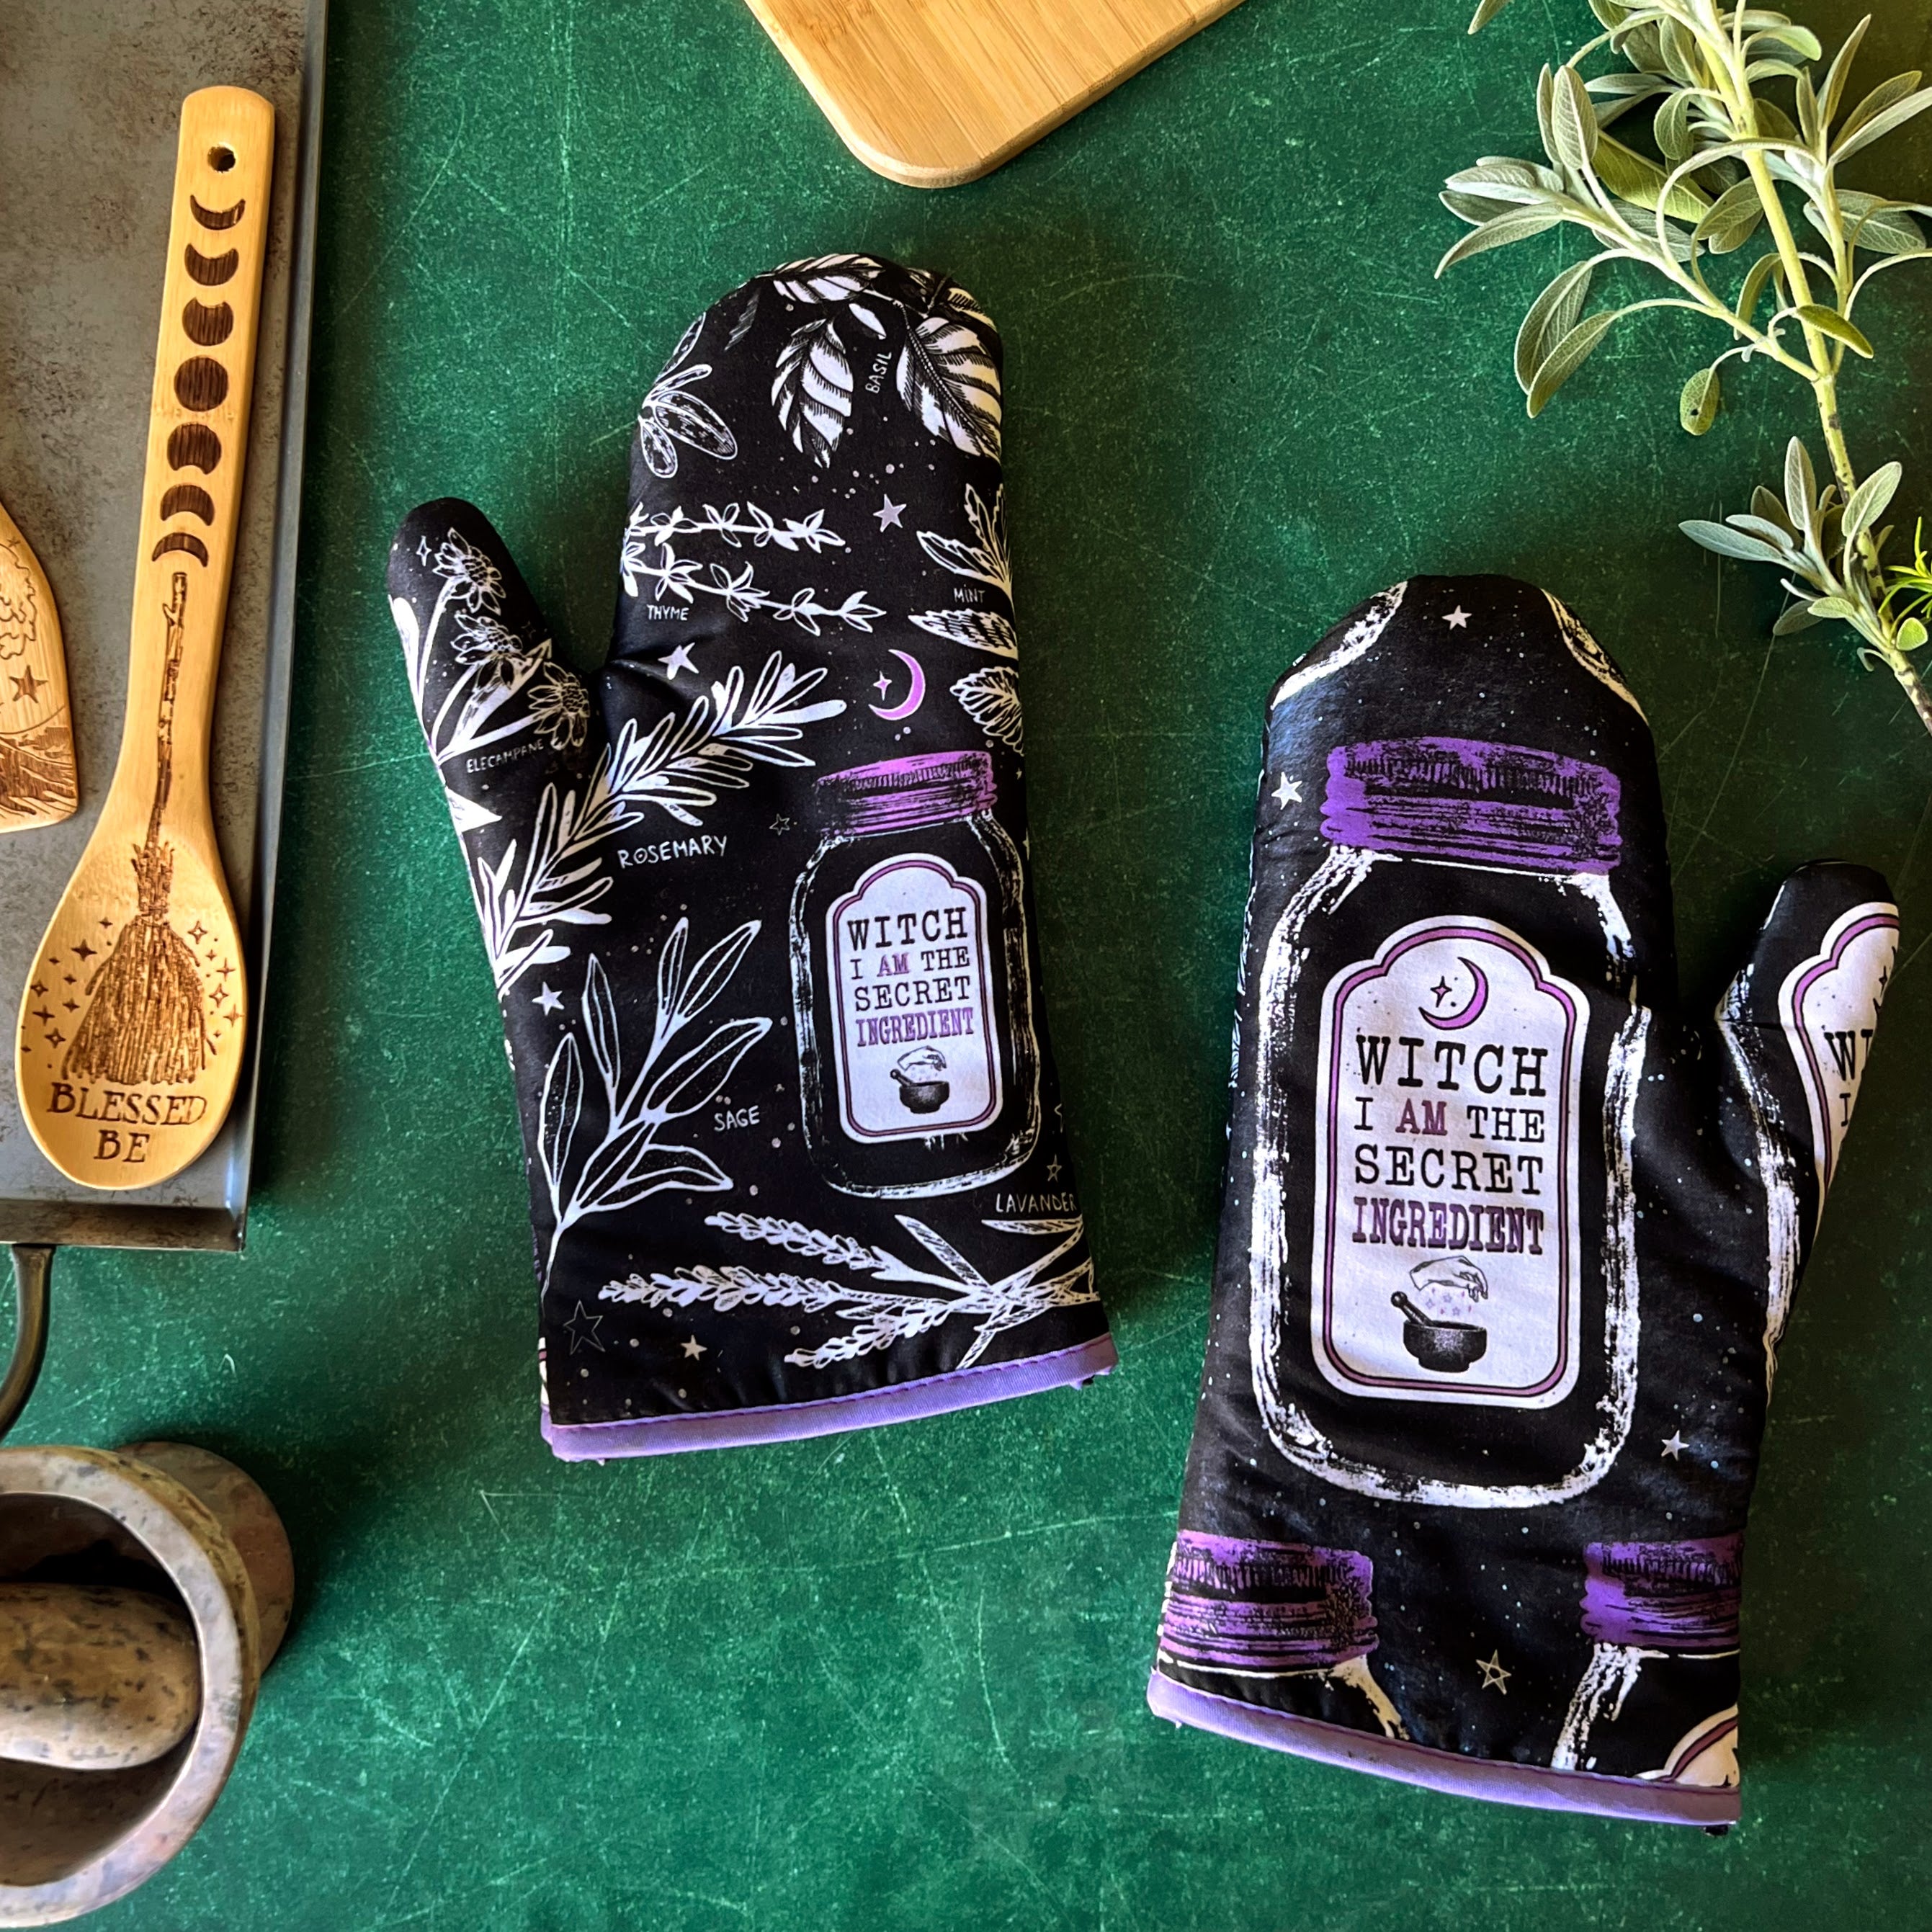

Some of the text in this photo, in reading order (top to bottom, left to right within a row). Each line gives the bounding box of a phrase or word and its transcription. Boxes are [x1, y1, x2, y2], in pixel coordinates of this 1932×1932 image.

[865, 351, 893, 394] BASIL
[647, 604, 688, 620] THYME
[466, 738, 544, 774] ELECAMPANE
[617, 836, 728, 868] ROSEMARY
[847, 906, 968, 951] WITCH
[850, 946, 970, 980] I AM THE
[854, 975, 971, 1011] SECRET
[856, 1007, 974, 1047] INGREDIENT
[1356, 1034, 1548, 1097] WITCH
[46, 1082, 207, 1125] BLESSED
[714, 1105, 760, 1132] SAGE
[1354, 1097, 1545, 1143] I AM THE
[94, 1130, 150, 1163] BE
[1354, 1144, 1544, 1195] SECRET
[995, 1191, 1078, 1214] LAVANDER
[1351, 1197, 1544, 1254] INGREDIENT
